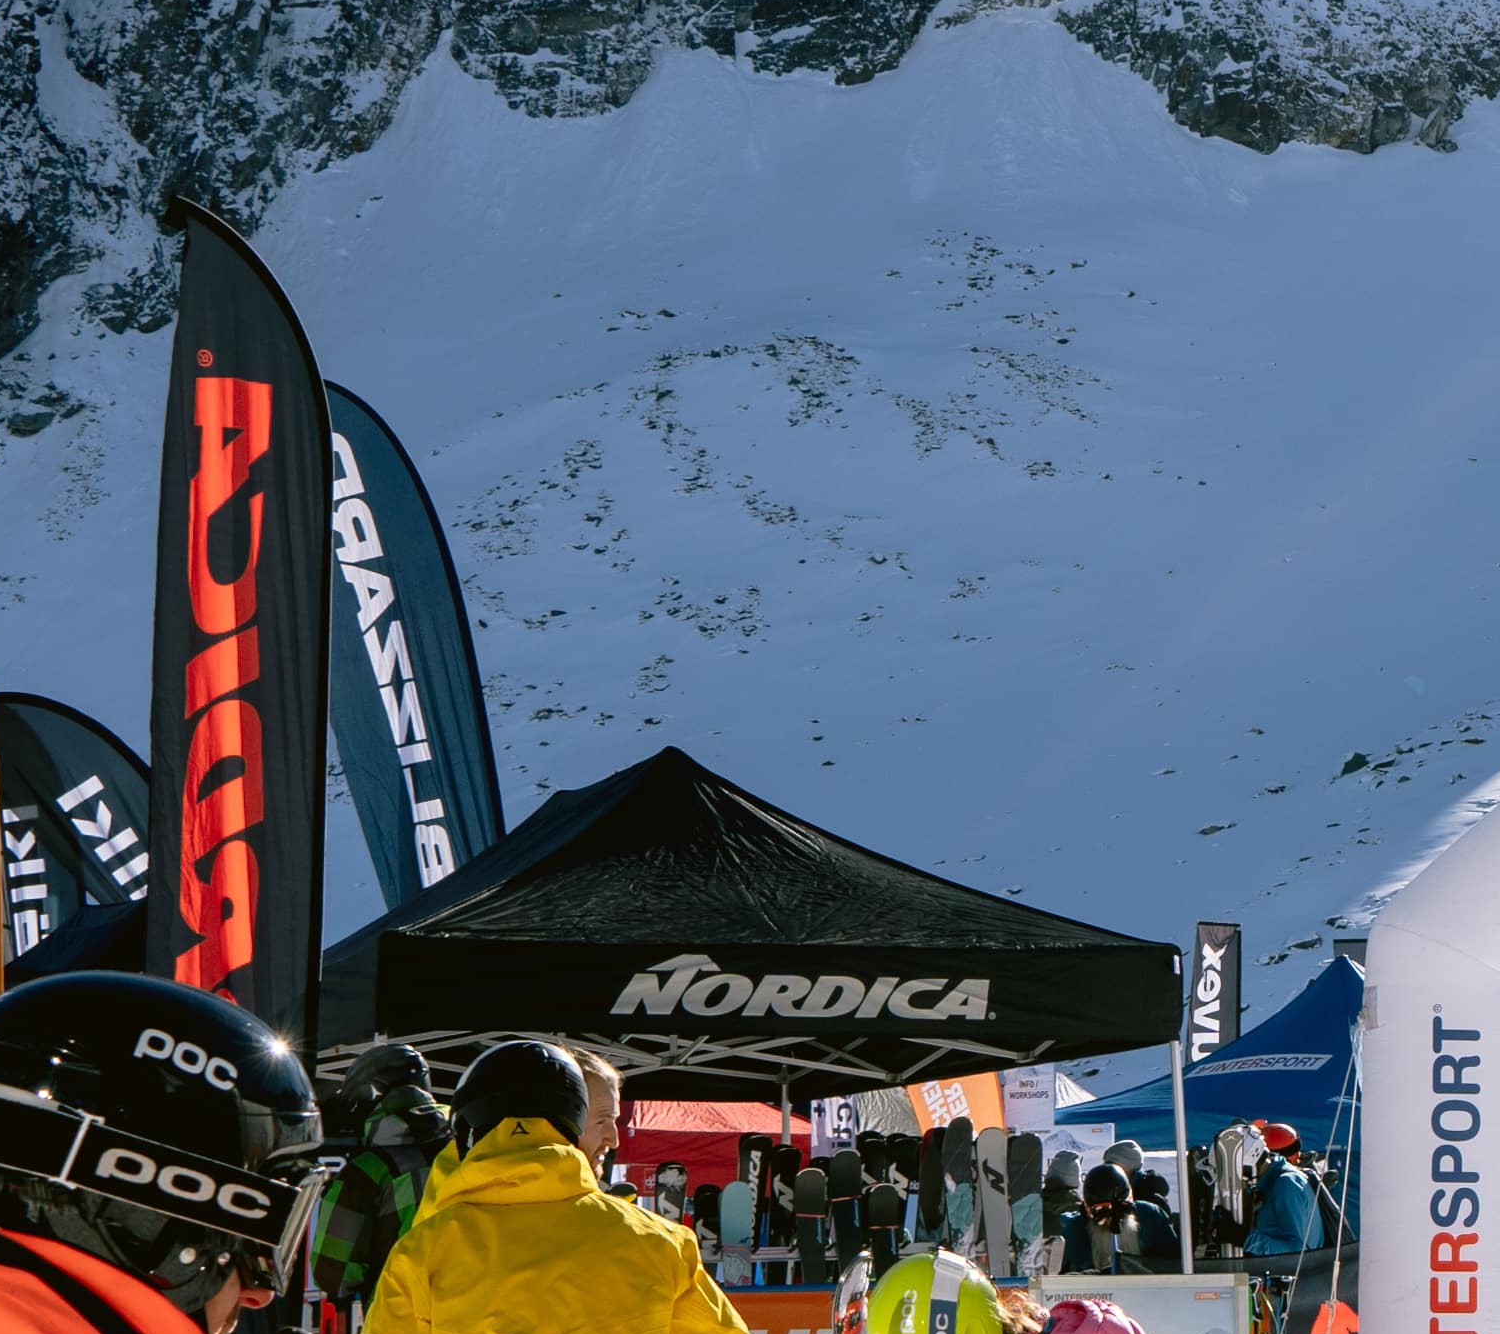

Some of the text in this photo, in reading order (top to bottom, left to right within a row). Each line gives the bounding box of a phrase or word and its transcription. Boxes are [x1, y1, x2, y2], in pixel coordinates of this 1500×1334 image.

[610, 954, 992, 1020] NORDICA
[1215, 1055, 1323, 1072] INTERSPORT
[1019, 1080, 1034, 1088] INFO
[1009, 1090, 1049, 1100] WORKSHOPS
